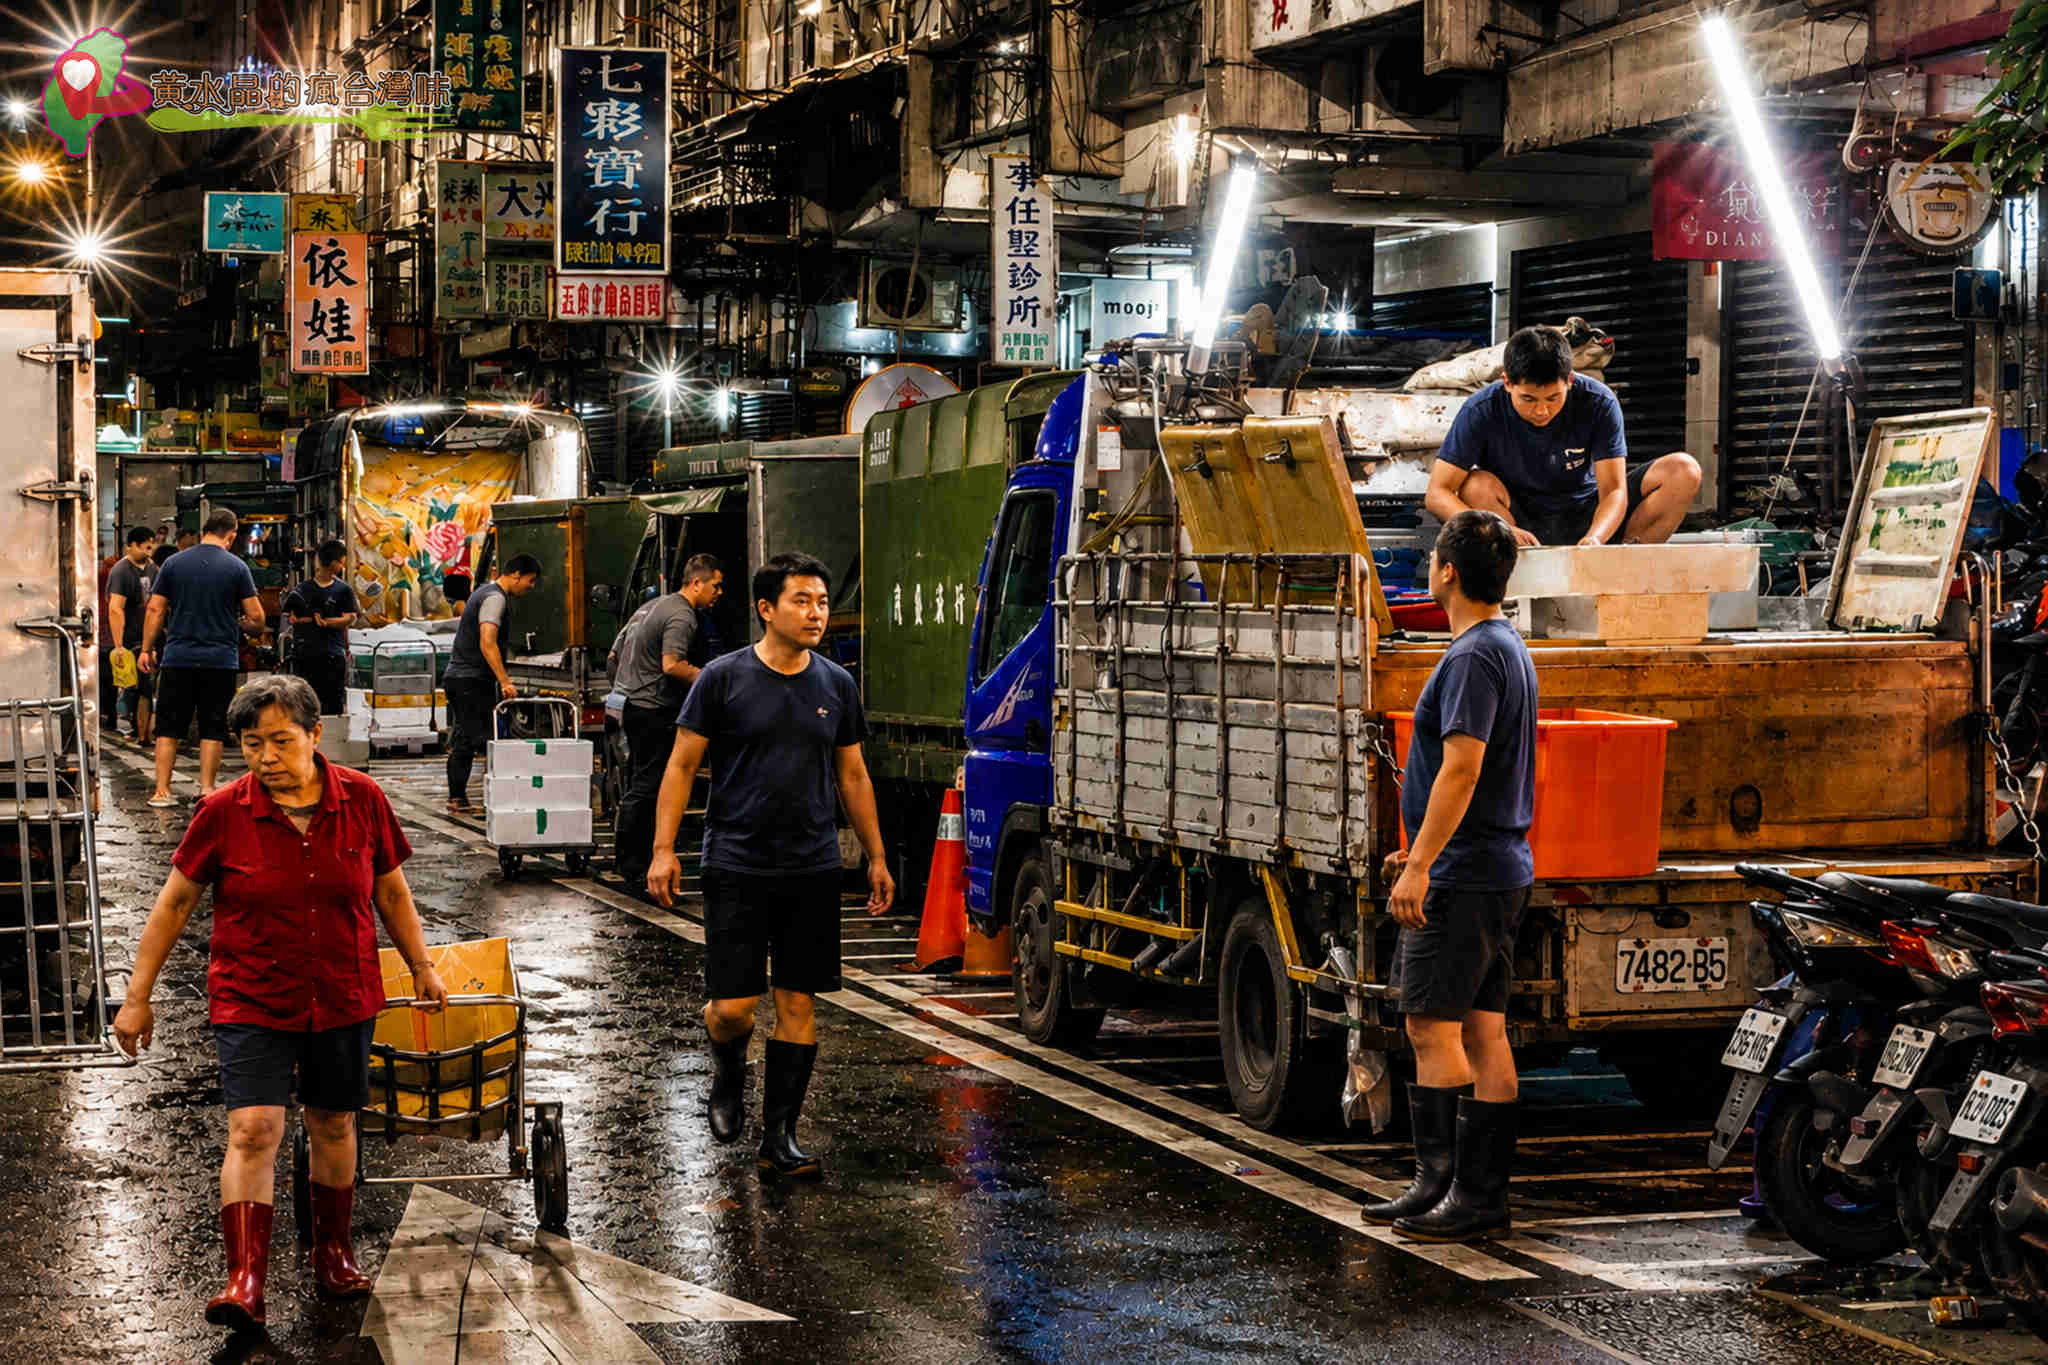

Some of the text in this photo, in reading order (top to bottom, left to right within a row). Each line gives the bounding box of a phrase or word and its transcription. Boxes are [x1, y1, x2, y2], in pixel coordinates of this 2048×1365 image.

[583, 54, 647, 237] 七彩寶行
[303, 238, 358, 345] 依娃
